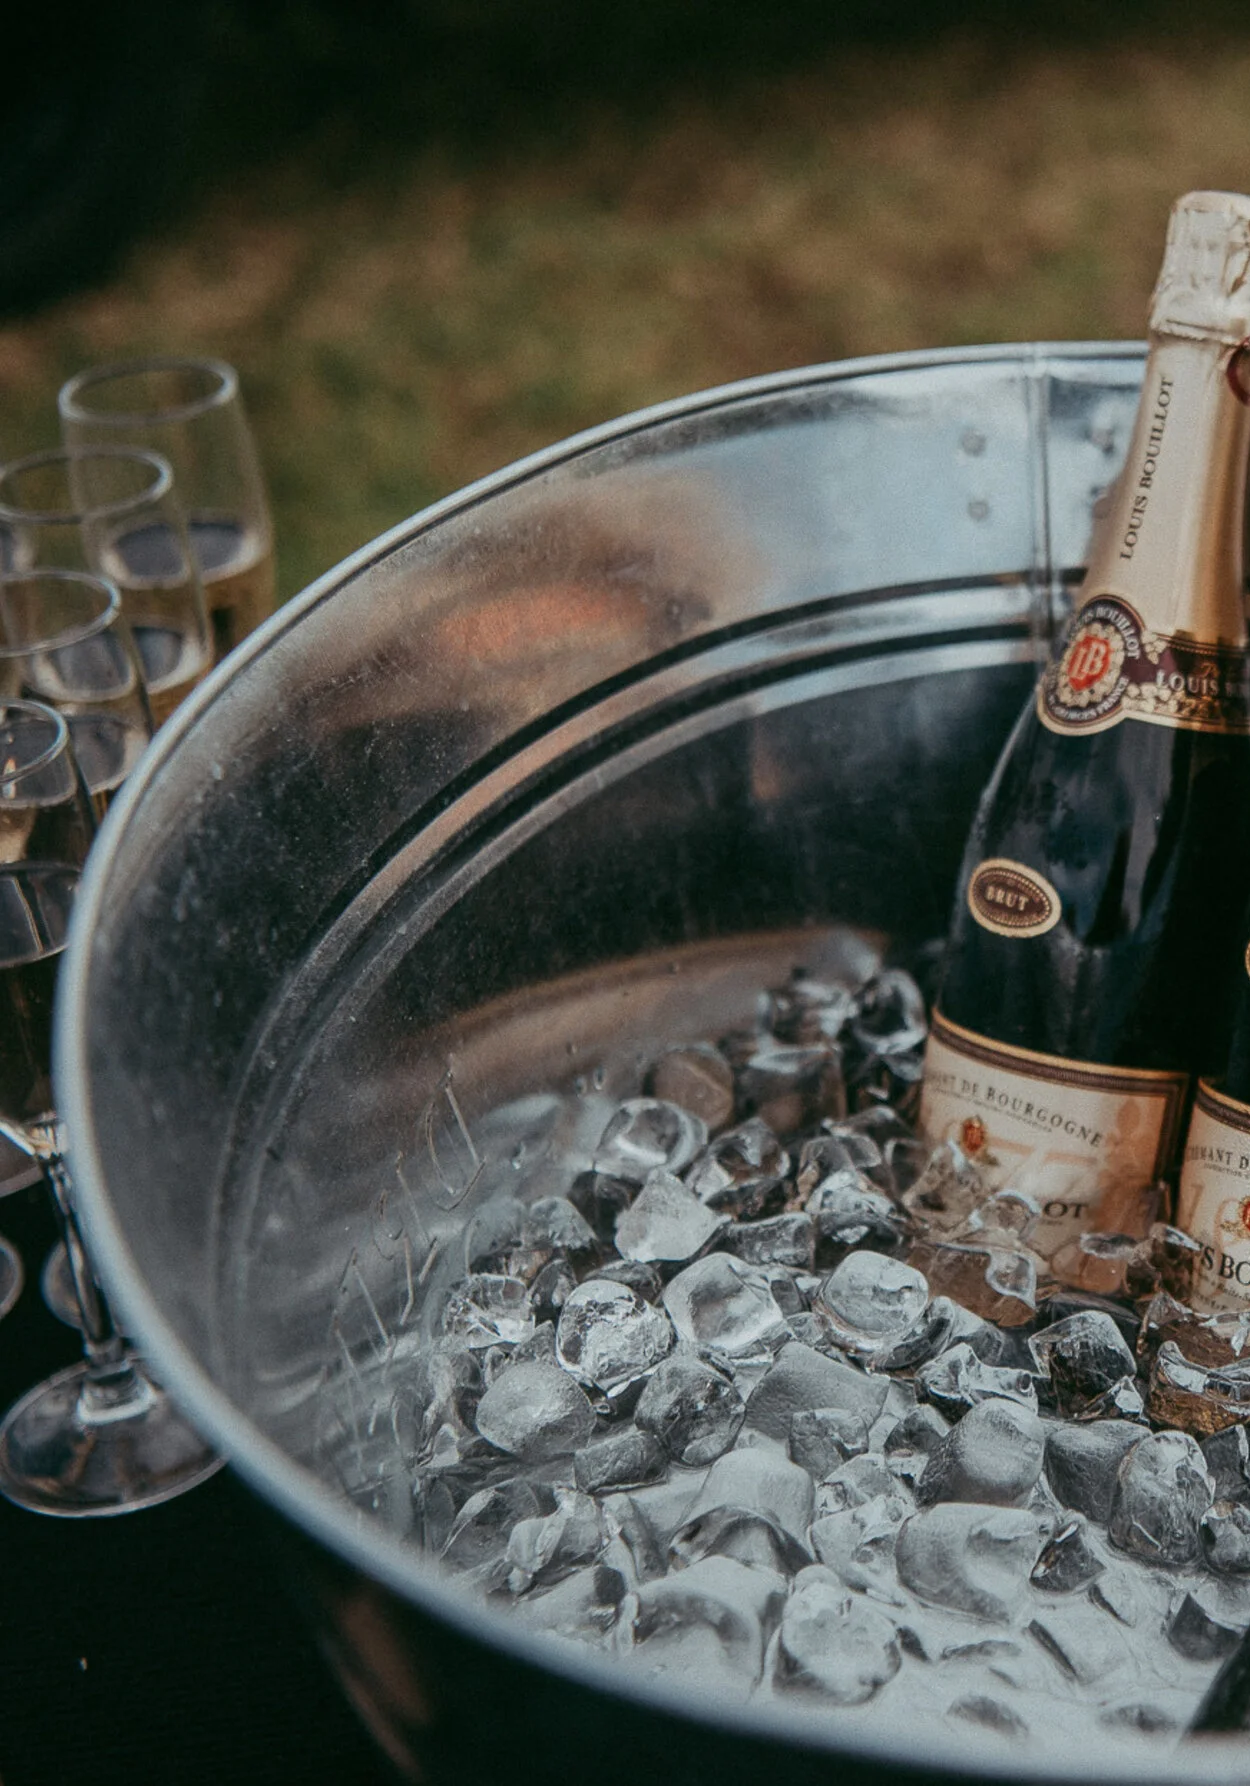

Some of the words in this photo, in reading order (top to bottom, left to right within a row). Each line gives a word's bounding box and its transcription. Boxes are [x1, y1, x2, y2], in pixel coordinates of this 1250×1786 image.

[1119, 495, 1149, 561] LOUIS
[1138, 376, 1175, 491] BOUILLOT
[985, 886, 1029, 912] BRUT
[985, 1086, 1103, 1148] BOURGOGNE
